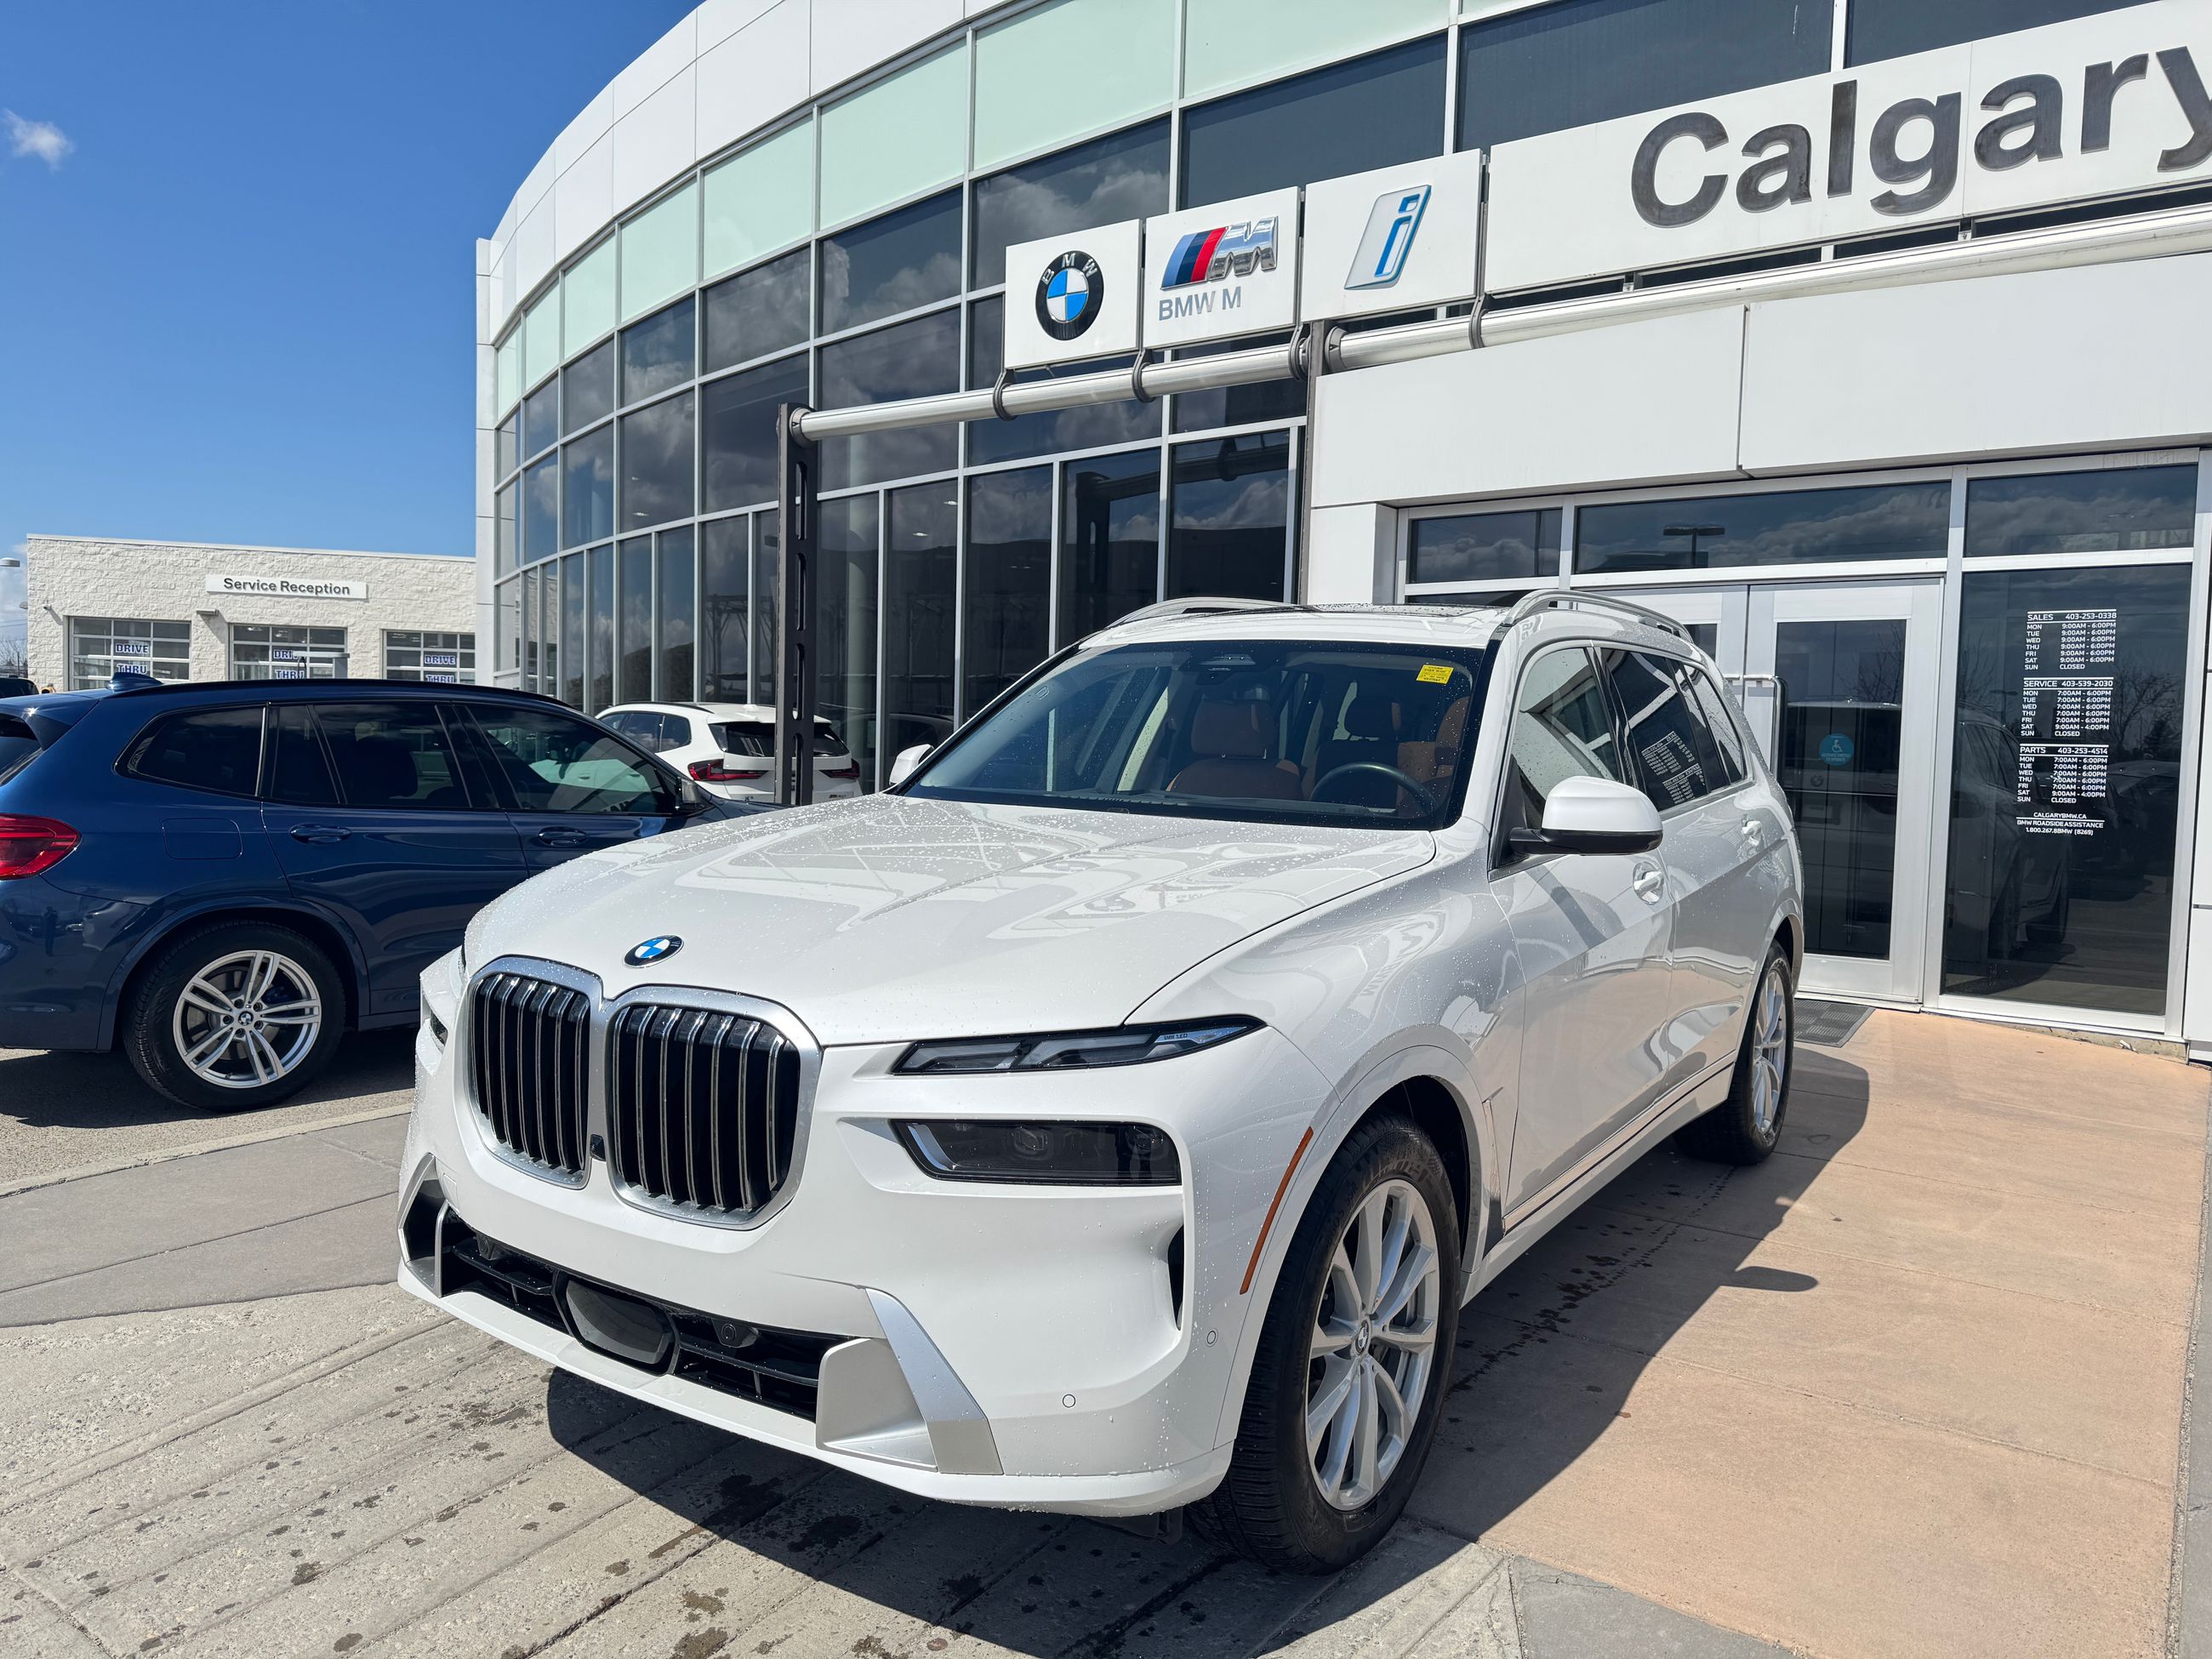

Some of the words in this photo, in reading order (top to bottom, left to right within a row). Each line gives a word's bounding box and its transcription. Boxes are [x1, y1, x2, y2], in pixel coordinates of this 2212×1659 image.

[1630, 46, 2212, 229] Calgary
[1041, 253, 1097, 285] BMW
[1159, 290, 1216, 321] BMW
[1223, 286, 1241, 311] M
[224, 578, 276, 591] Service
[280, 580, 350, 596] Reception
[116, 643, 149, 653] DRIVE
[425, 654, 456, 664] DRIVE
